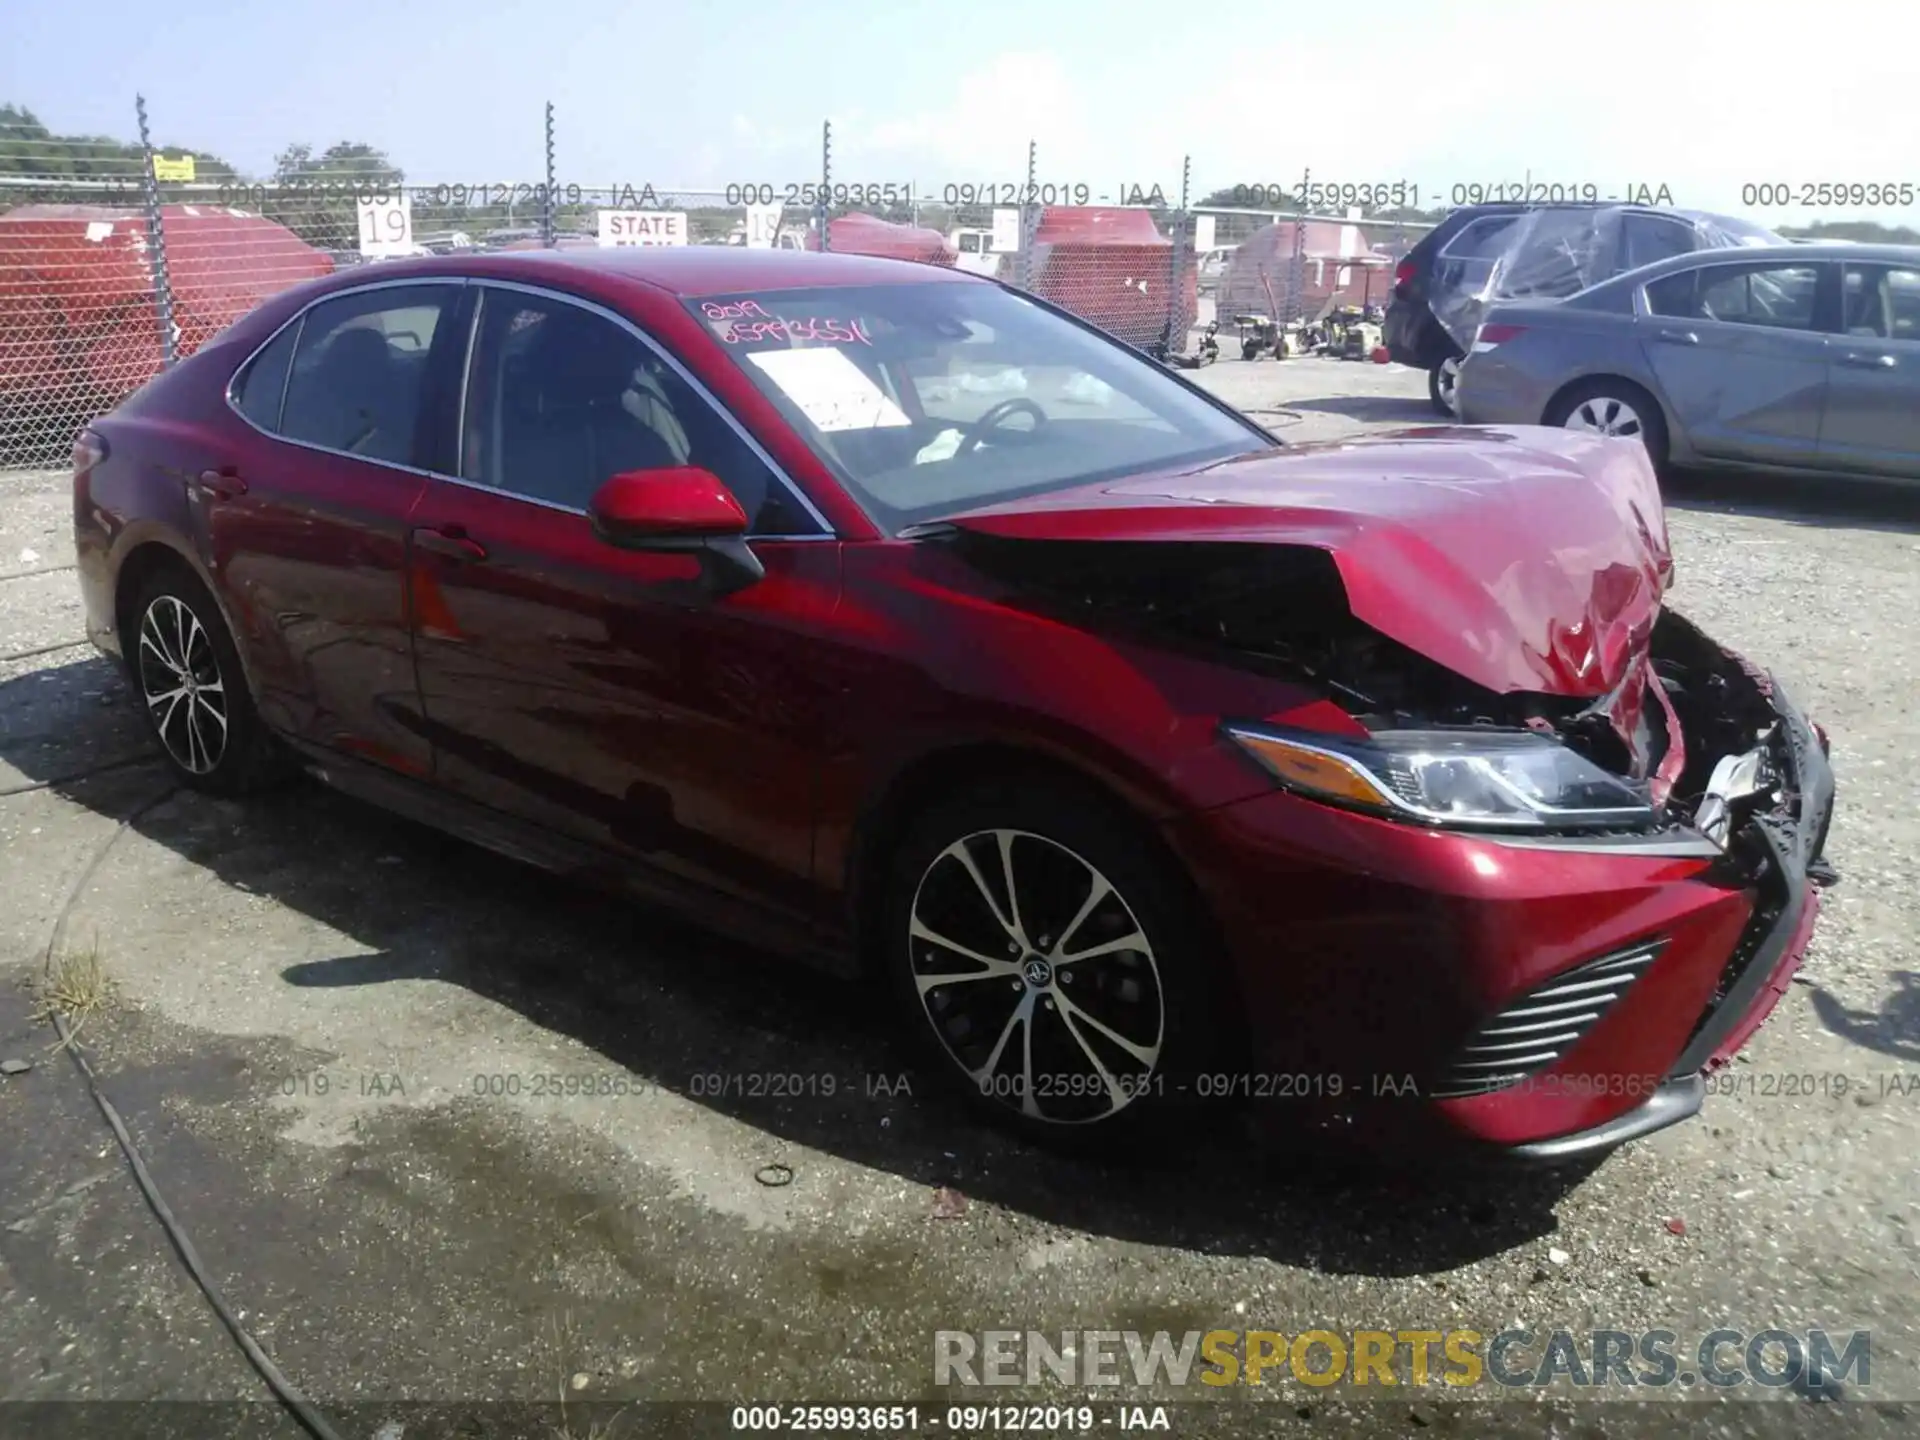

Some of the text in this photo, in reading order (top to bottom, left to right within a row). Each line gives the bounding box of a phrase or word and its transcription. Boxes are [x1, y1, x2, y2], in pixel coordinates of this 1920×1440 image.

[364, 210, 407, 243] 19
[610, 216, 677, 235] STATE
[702, 301, 771, 320] 2019
